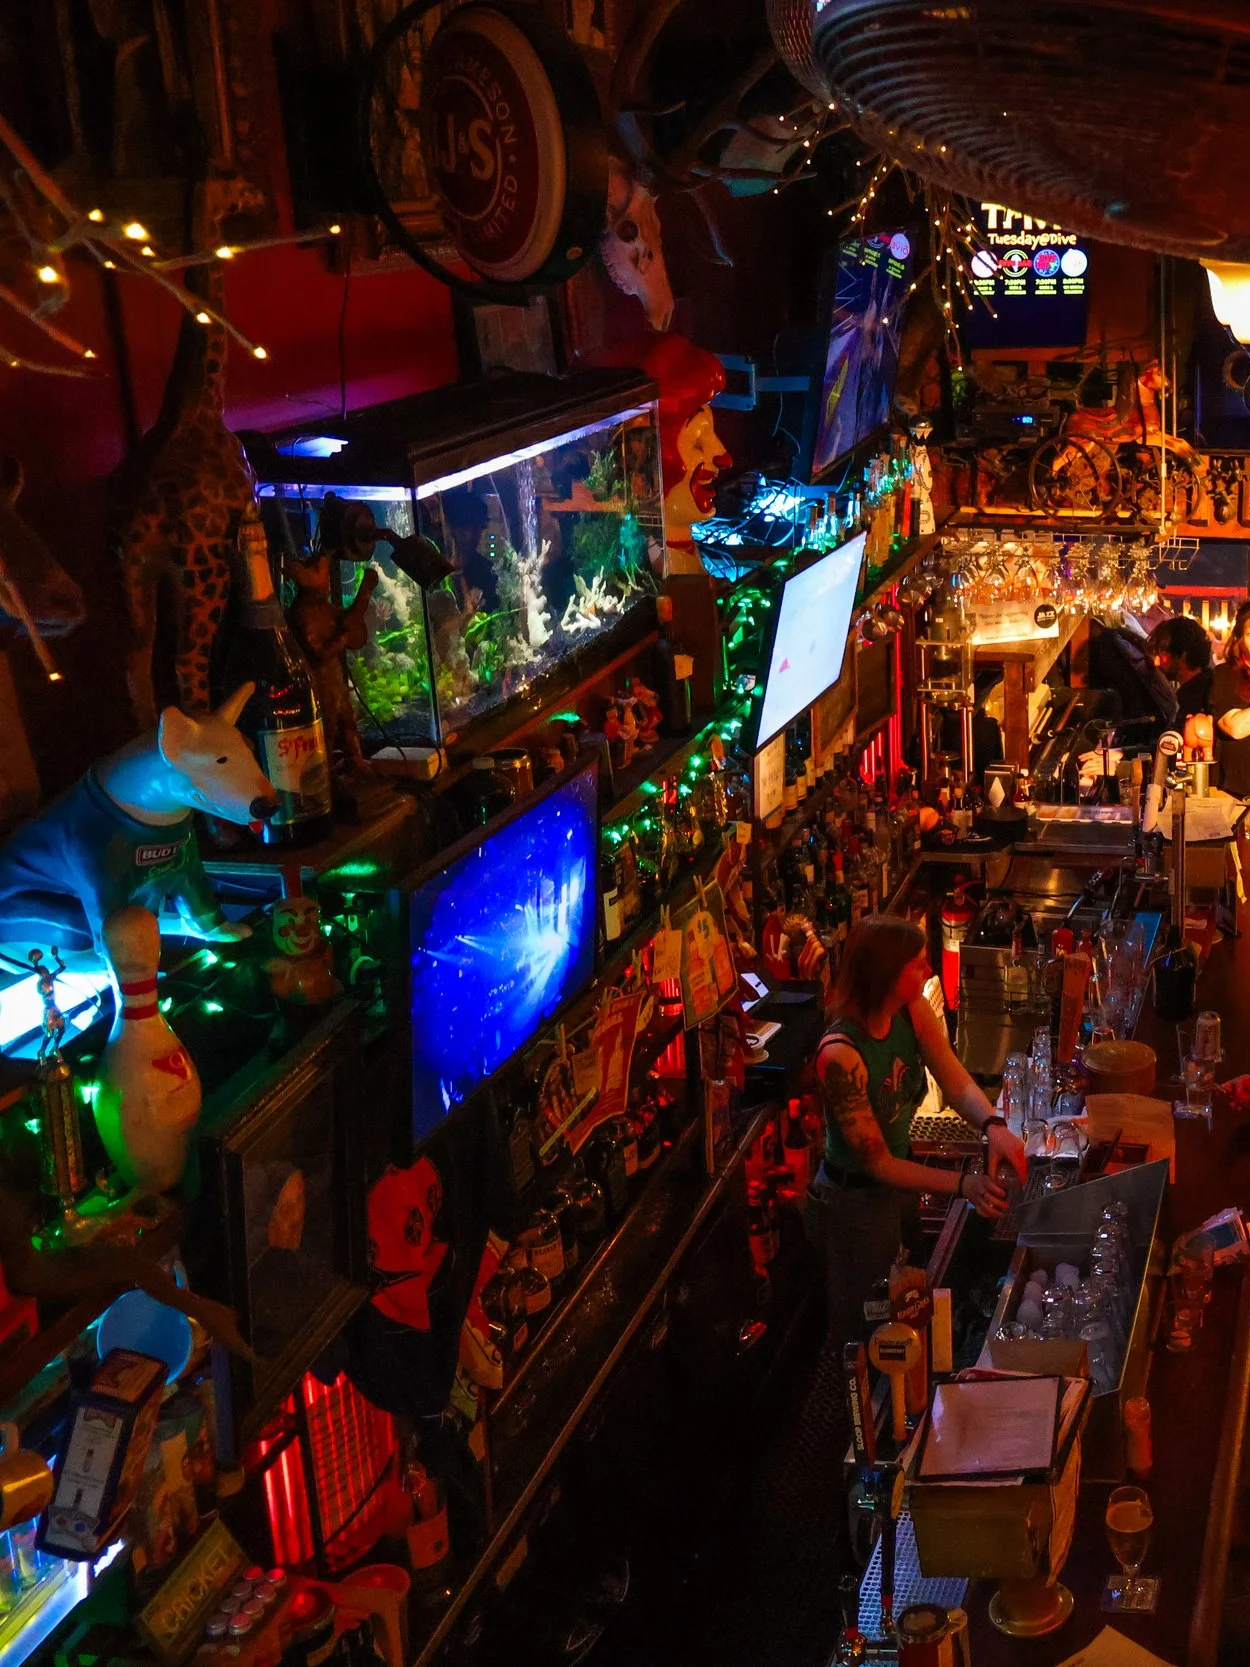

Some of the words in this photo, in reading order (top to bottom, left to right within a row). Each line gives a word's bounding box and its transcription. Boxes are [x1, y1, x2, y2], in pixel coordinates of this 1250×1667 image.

[142, 847, 172, 860] BUD
[850, 1392, 861, 1426] BREWING
[855, 1427, 865, 1451] SLOOP
